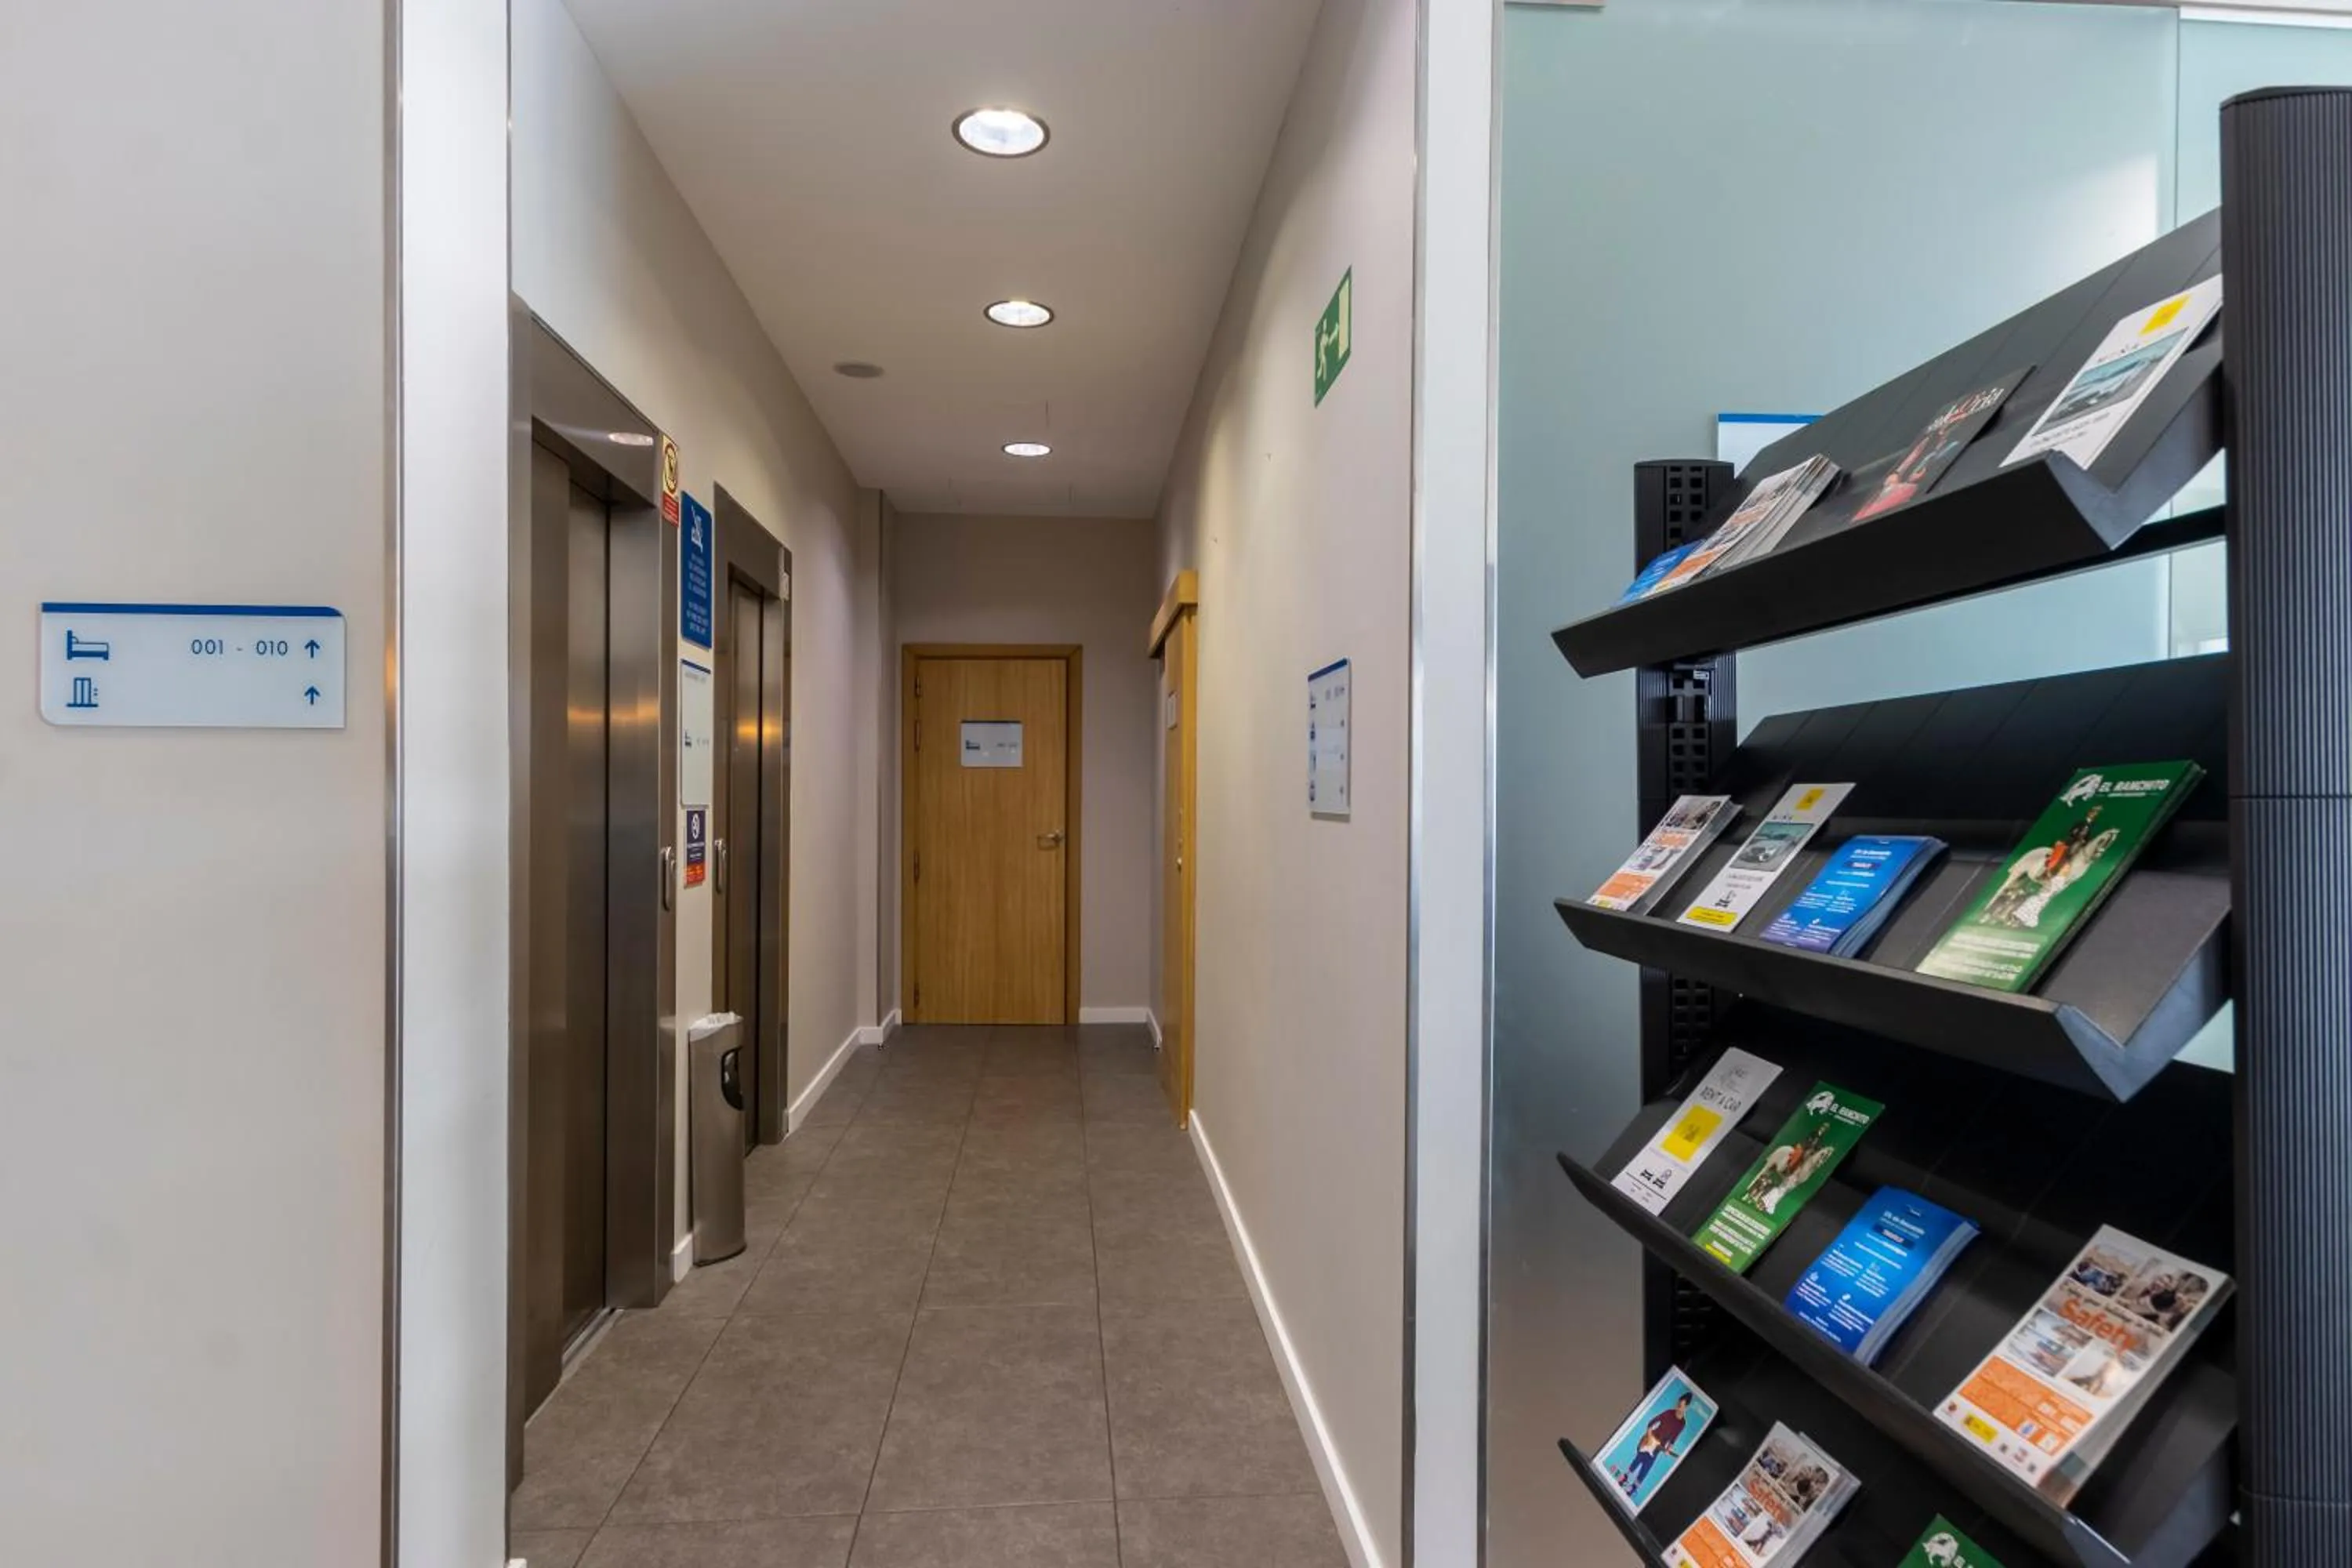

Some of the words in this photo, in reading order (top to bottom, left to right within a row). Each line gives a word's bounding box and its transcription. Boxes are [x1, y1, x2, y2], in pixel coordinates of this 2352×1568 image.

[190, 639, 224, 655] 001
[256, 640, 289, 656] 010
[2058, 1298, 2140, 1356] Safety
